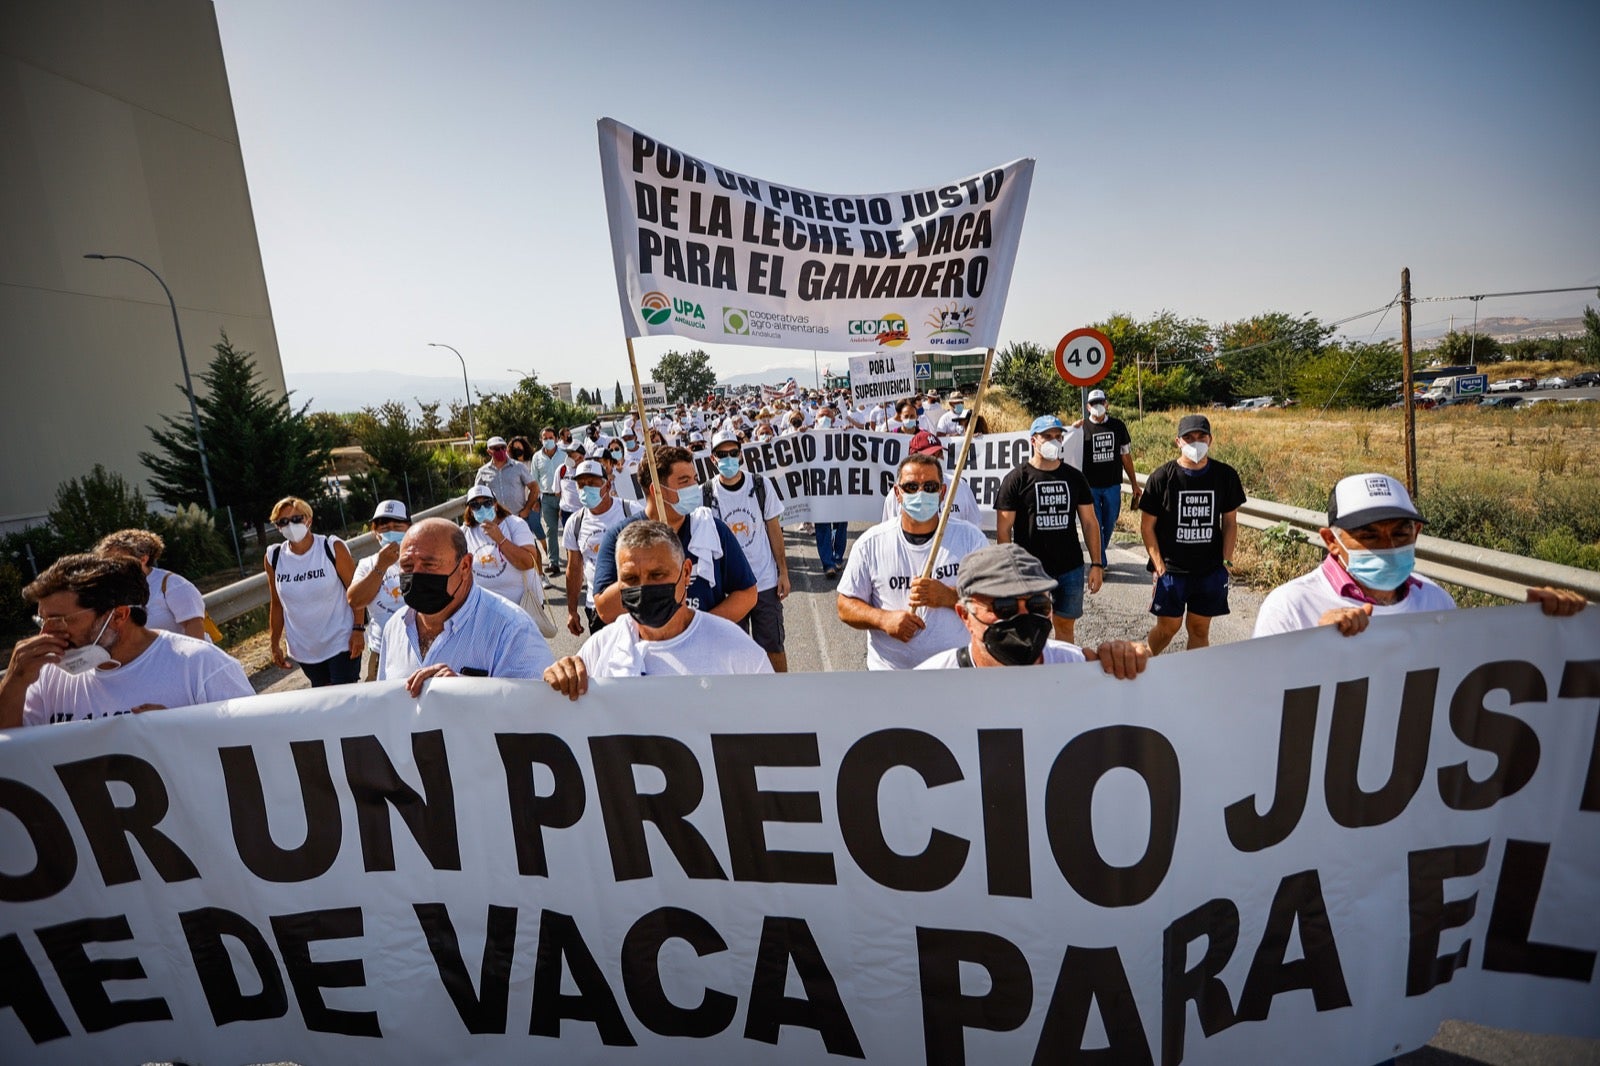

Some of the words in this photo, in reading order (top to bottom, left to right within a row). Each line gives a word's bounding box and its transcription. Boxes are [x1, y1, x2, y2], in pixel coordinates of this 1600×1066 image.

[632, 132, 706, 183] POR
[713, 164, 762, 200] UN
[769, 185, 892, 226] PRECIO
[902, 168, 1005, 221] JUSTO
[634, 180, 679, 229] DE
[689, 192, 732, 239] LA
[743, 200, 854, 257] LECHE
[862, 229, 907, 260] DE
[912, 209, 992, 258] VACA
[639, 227, 737, 291] PARA
[747, 251, 787, 298] EL
[797, 255, 989, 301] GANADERO
[673, 297, 705, 320] UPA
[750, 310, 809, 325] cooperativas
[849, 320, 904, 333] COAG
[1067, 346, 1102, 367] 40
[869, 359, 884, 375] POR
[886, 357, 895, 373] LA
[855, 378, 911, 399] SUPERVIVENCIA
[743, 434, 816, 474] RECIO
[823, 433, 900, 466] JUSTO
[947, 442, 977, 470] LA
[985, 438, 1034, 470] LEC
[848, 468, 873, 496] EL
[1042, 486, 1055, 494] CON
[1055, 485, 1064, 493] LA
[1040, 494, 1067, 505] LECHE
[1185, 496, 1199, 504] CON
[1199, 496, 1208, 504] LA
[1049, 506, 1056, 514] AL
[1182, 506, 1210, 517] LECHE
[1036, 514, 1069, 527] CUELLO
[1191, 519, 1199, 527] AL
[1176, 527, 1213, 540] CUELLO
[293, 572, 306, 581] del
[306, 568, 325, 579] SUR
[217, 729, 462, 884] UN
[494, 724, 1182, 909] PRECIO
[178, 906, 383, 1038] DE
[412, 903, 867, 1060] VACA
[916, 869, 1353, 1066] PARA
[1406, 838, 1598, 998] EL
